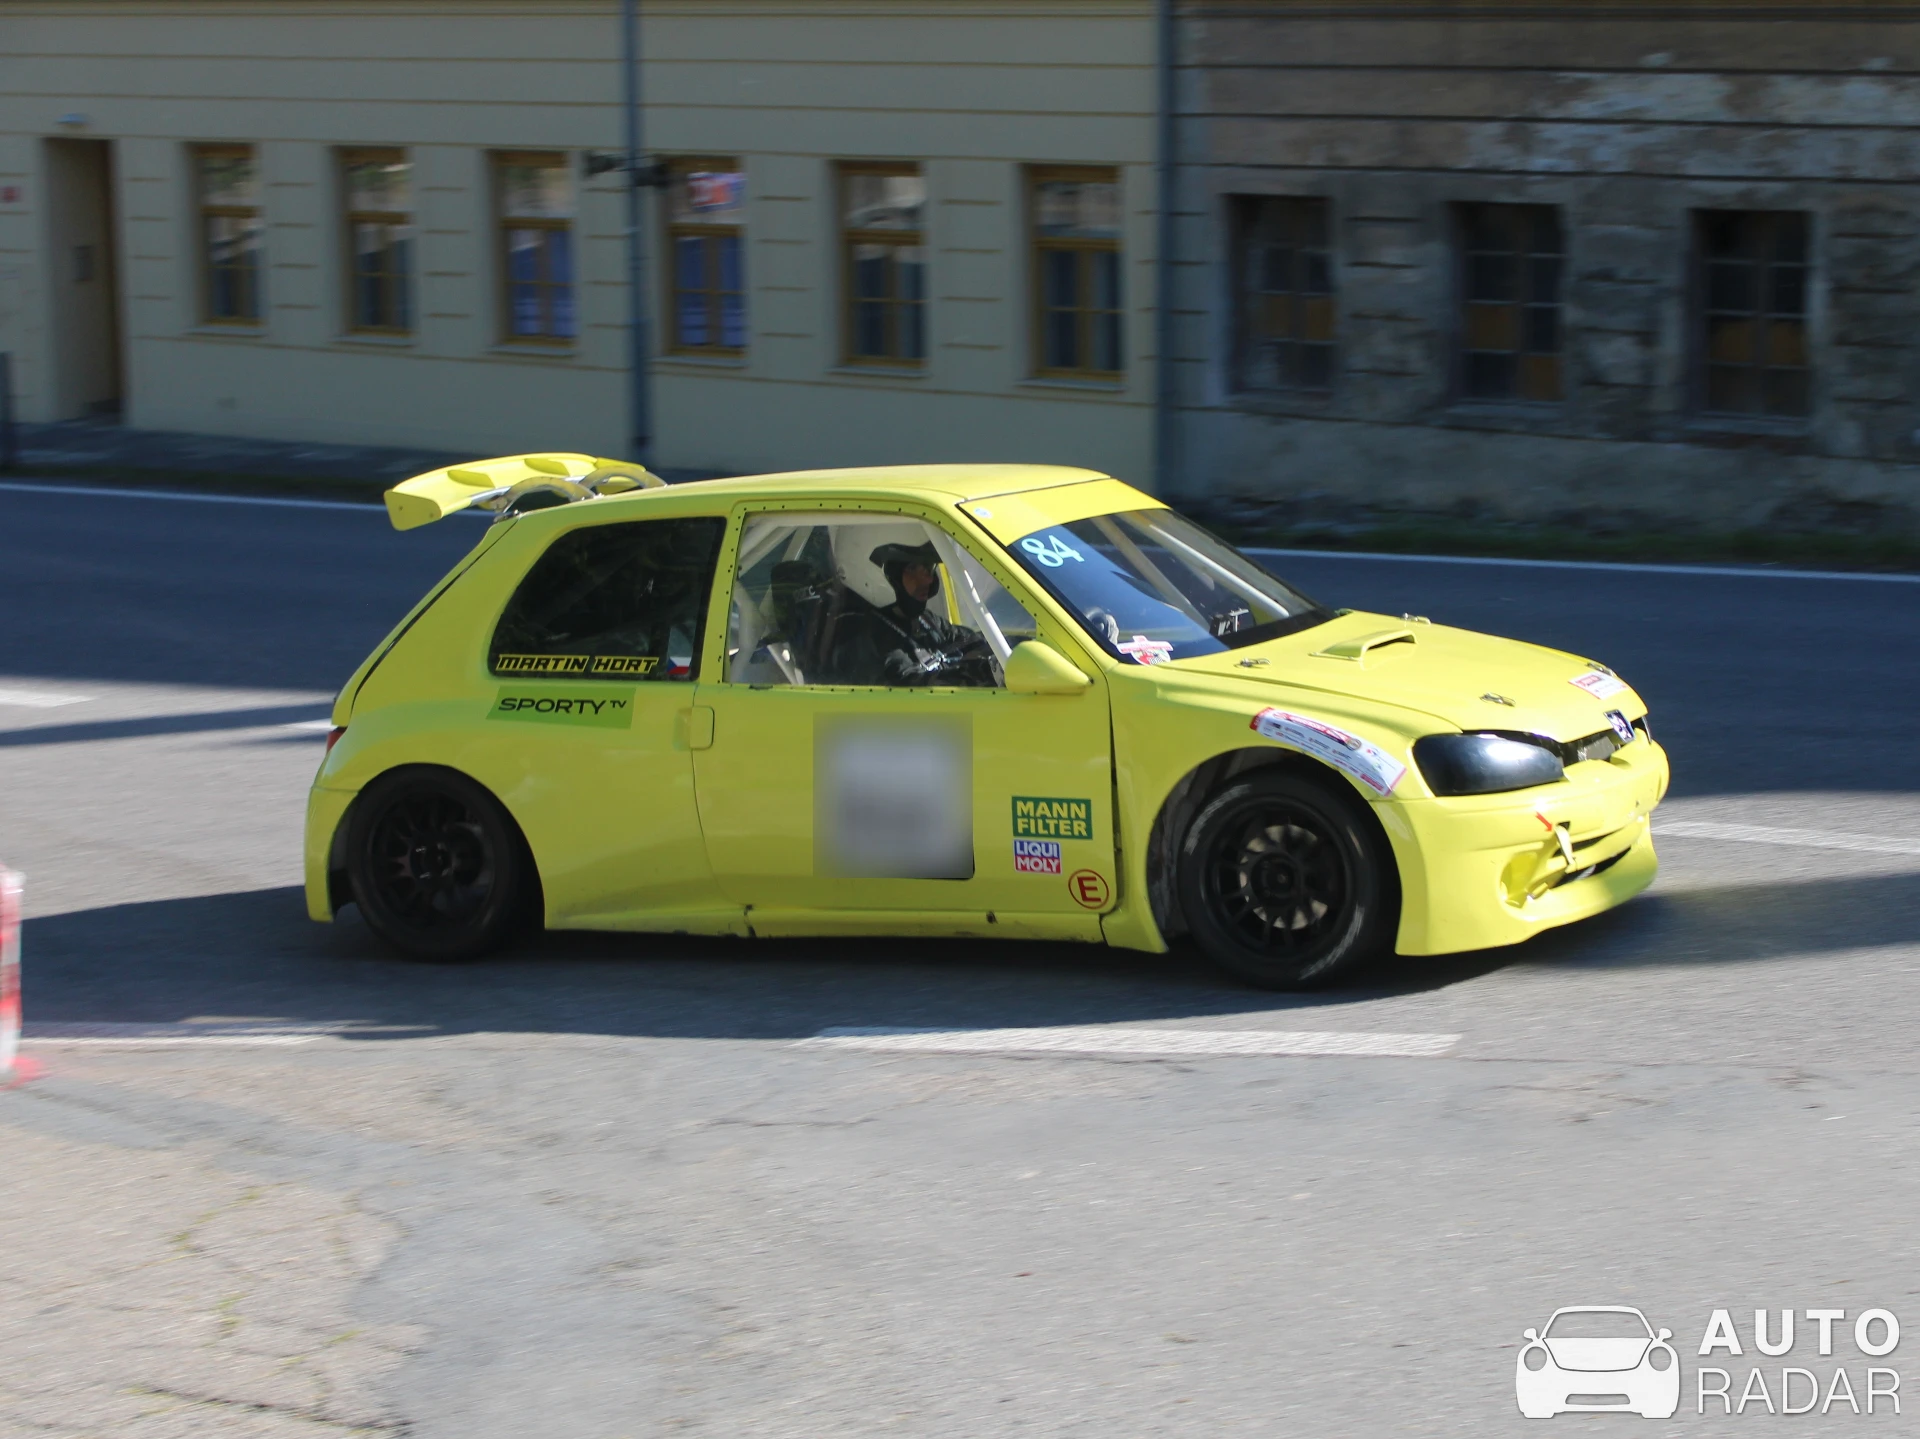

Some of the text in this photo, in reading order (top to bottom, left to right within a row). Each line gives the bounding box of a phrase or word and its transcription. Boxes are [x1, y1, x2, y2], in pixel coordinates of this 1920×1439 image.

[1021, 534, 1085, 568] 84
[497, 655, 658, 673] MARTIN HORT
[498, 698, 627, 715] SPORTY TV
[1016, 801, 1086, 819] MANN
[1017, 818, 1088, 836] FILTER
[1015, 841, 1058, 857] LIQUI
[1016, 856, 1060, 872] MOLY
[1077, 876, 1102, 902] E
